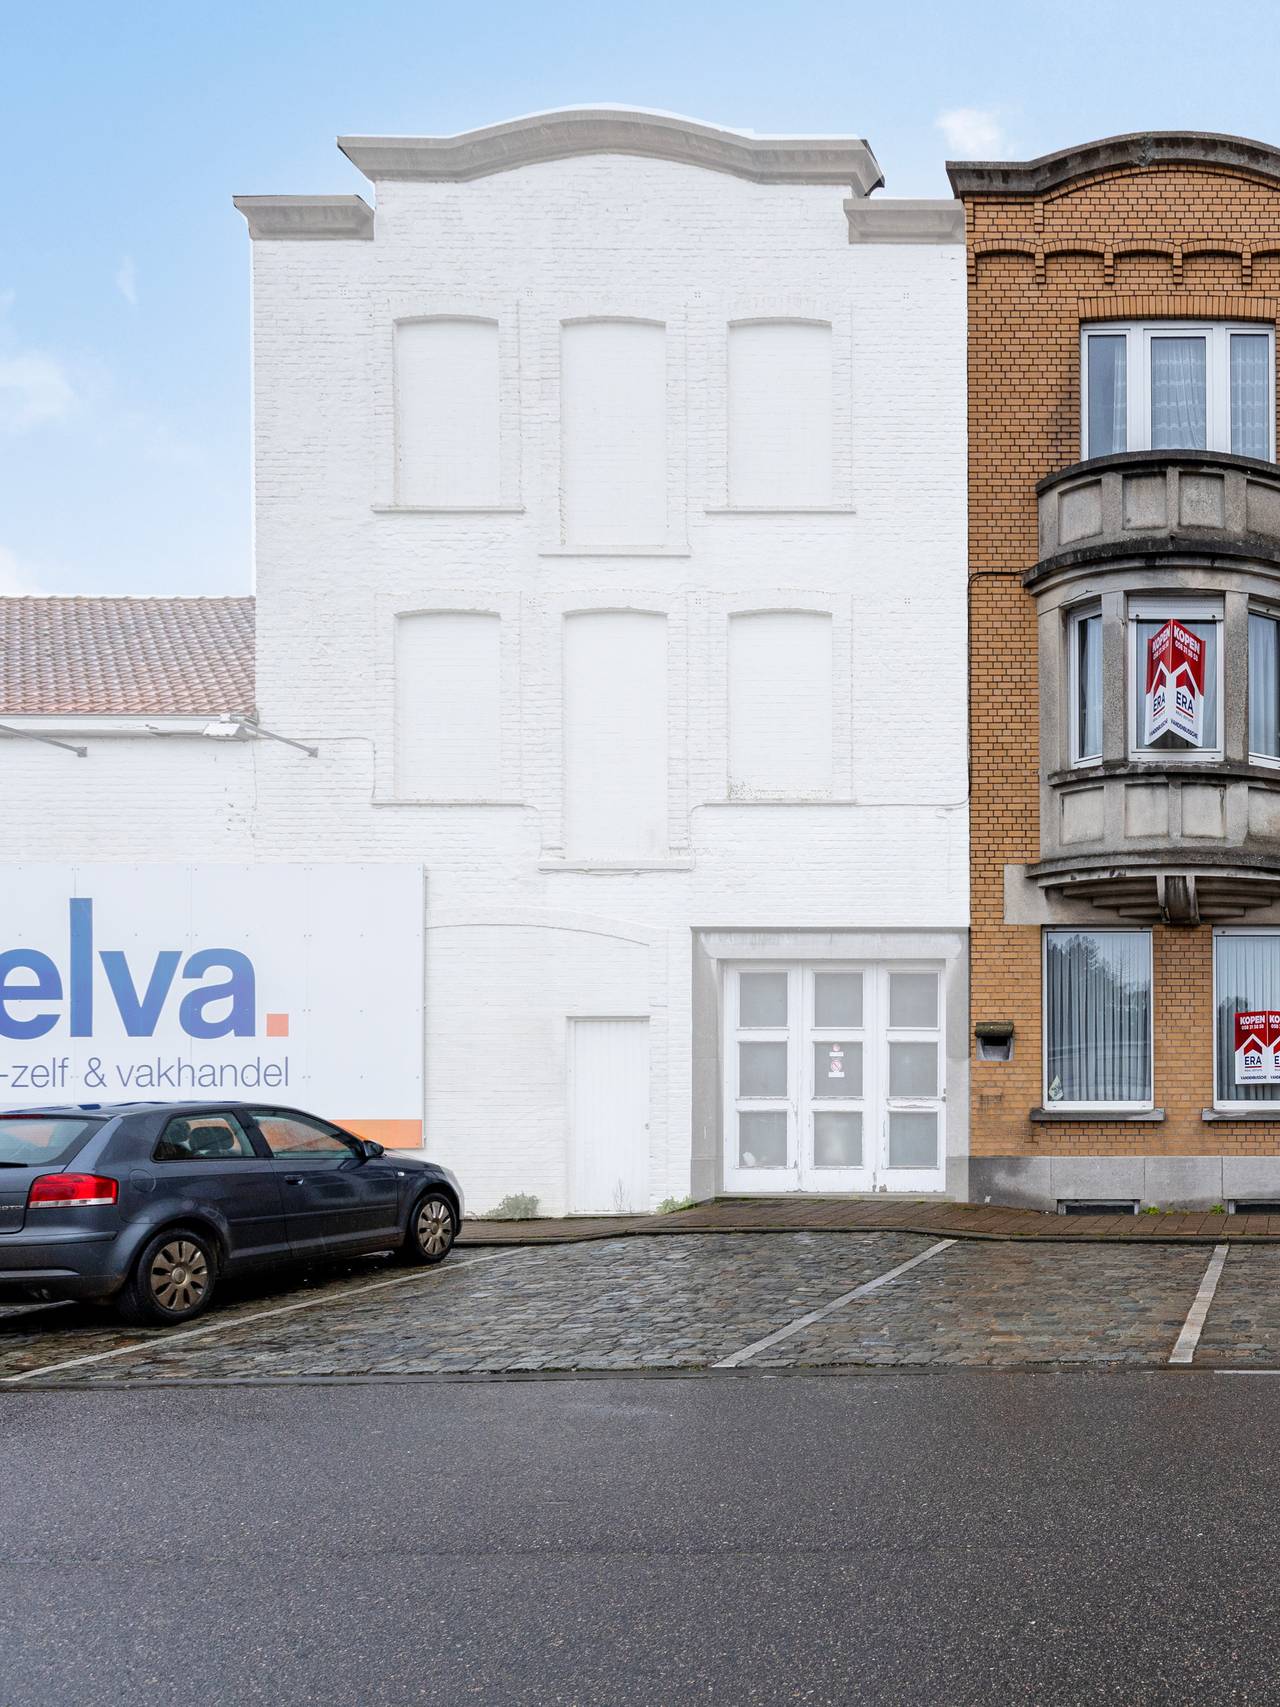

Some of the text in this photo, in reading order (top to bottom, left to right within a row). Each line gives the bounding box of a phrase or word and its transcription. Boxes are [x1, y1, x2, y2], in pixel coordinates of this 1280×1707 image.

[1173, 625, 1200, 656] KOPEN
[1153, 692, 1166, 712] ERA
[1176, 691, 1194, 714] ERA
[1240, 1015, 1266, 1025] KOPEN
[1244, 1056, 1262, 1065] ERA
[83, 1057, 107, 1088] &
[116, 1056, 289, 1088] vakhandel
